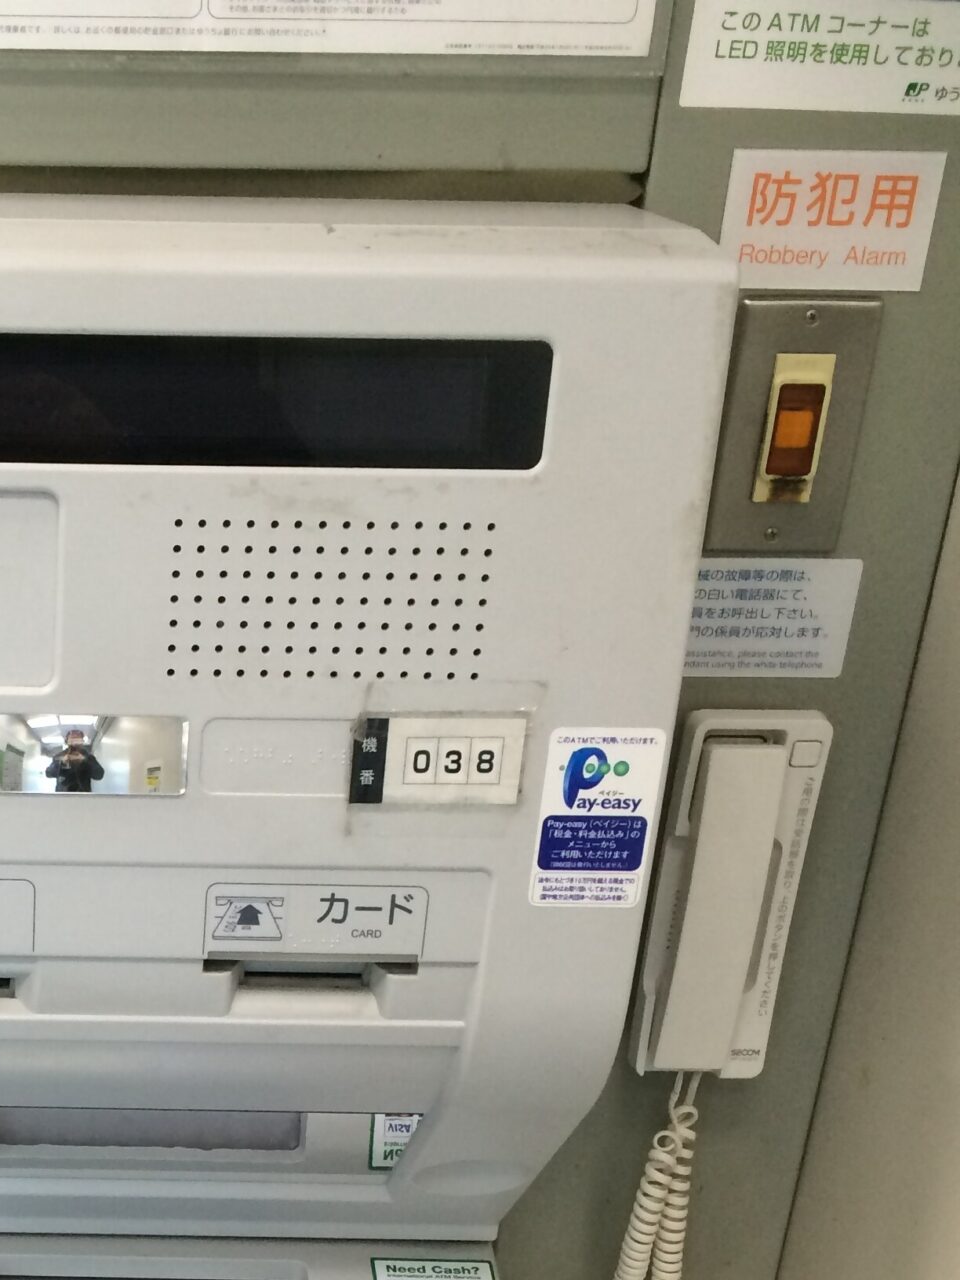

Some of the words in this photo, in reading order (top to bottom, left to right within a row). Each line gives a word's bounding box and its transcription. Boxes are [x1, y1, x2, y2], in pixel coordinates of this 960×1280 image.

[714, 39, 758, 59] LED
[763, 40, 960, 67] 照明を使用しており
[746, 171, 919, 228] 防犯用
[738, 244, 828, 269] Robbery
[843, 246, 907, 265] Alarm
[359, 737, 378, 785] 機番
[412, 750, 495, 774] 038
[562, 747, 642, 812] Pay-easy
[317, 893, 414, 925] カード
[351, 929, 382, 939] CARD
[386, 1265, 426, 1274] Need
[432, 1266, 480, 1275] Cash?
